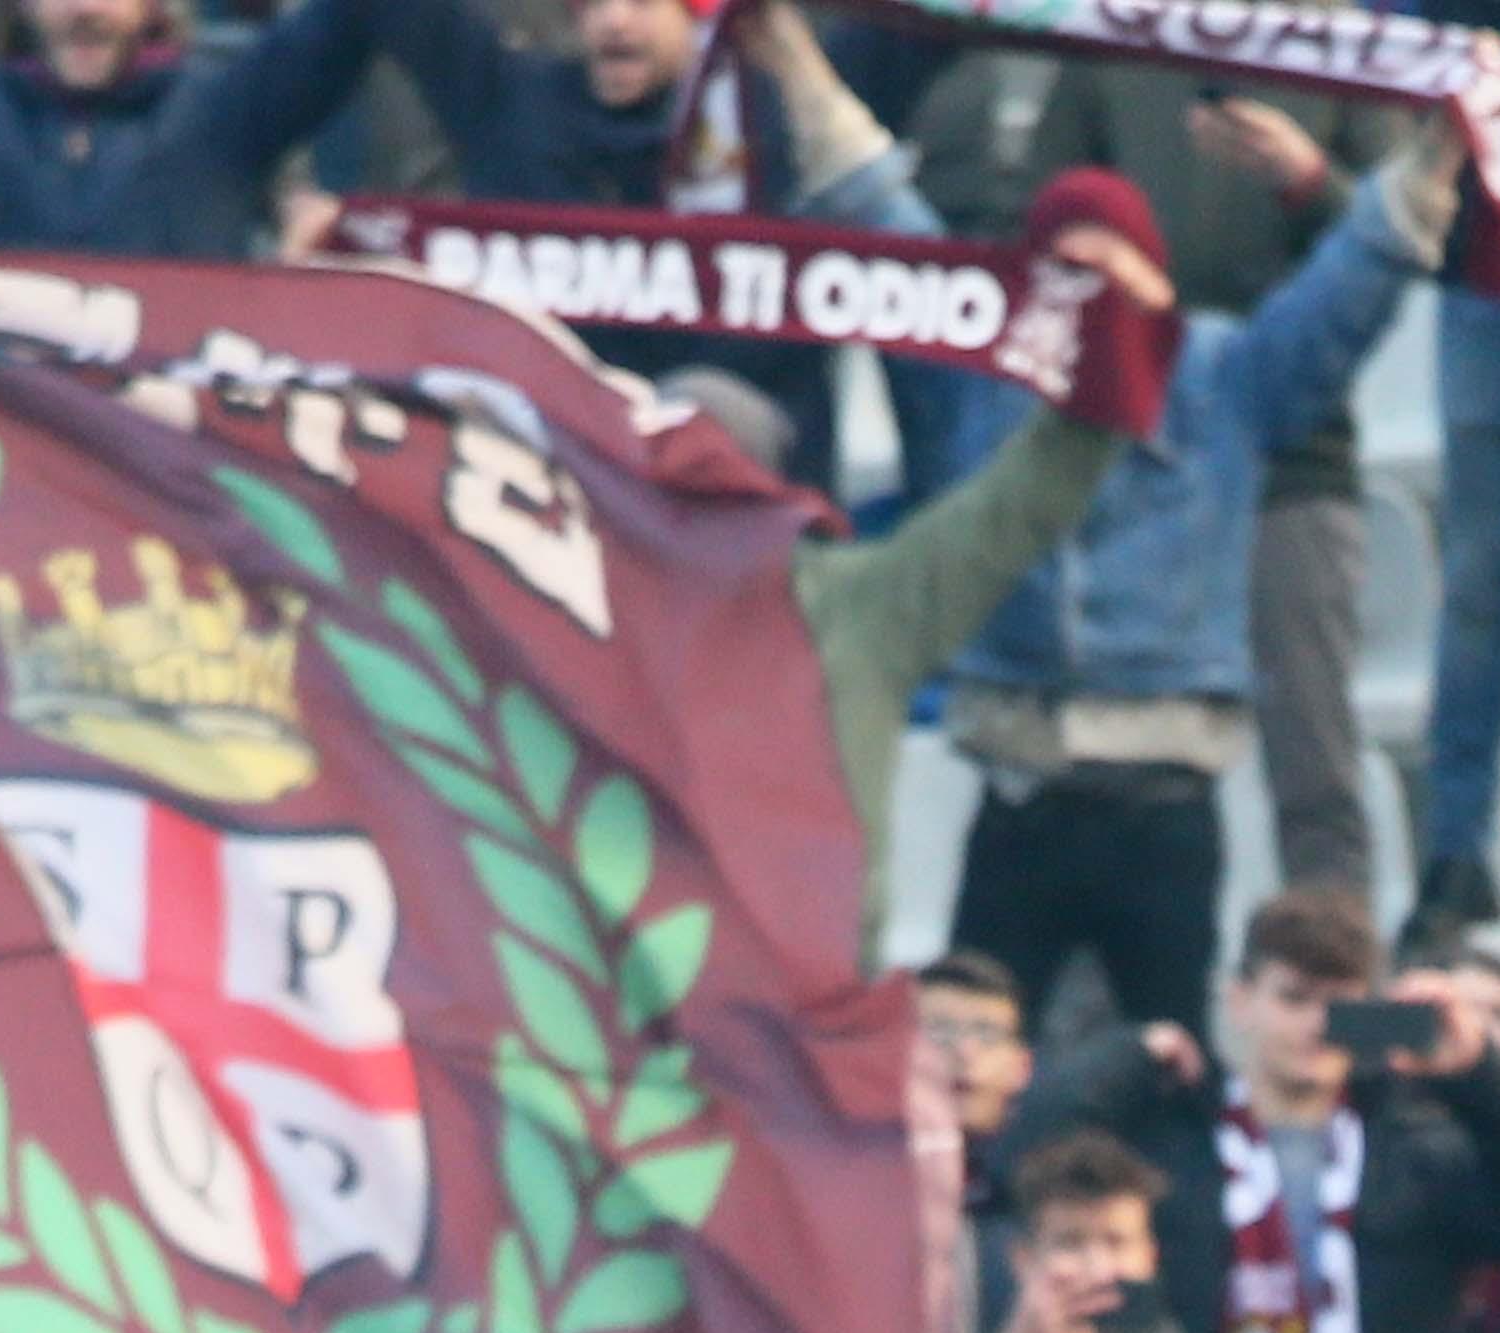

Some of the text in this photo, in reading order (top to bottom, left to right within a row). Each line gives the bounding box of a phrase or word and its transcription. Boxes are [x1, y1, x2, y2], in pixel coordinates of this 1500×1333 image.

[425, 229, 1008, 350] PARMA TI ODIO
[280, 886, 354, 1001] P
